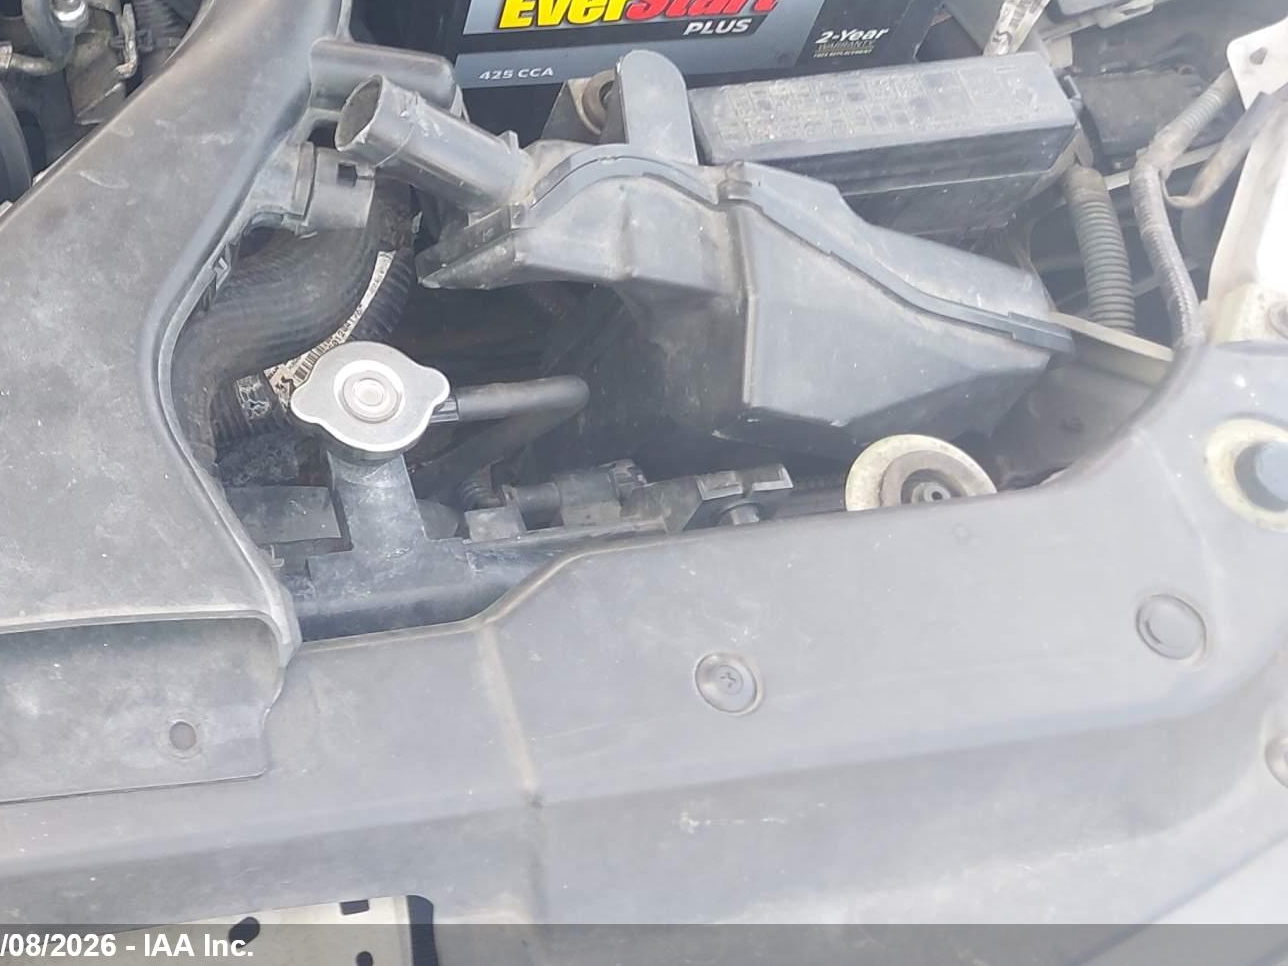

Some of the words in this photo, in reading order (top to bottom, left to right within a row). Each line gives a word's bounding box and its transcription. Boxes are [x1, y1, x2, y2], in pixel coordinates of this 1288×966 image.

[682, 17, 753, 36] PLUS
[815, 27, 889, 44] 2-Year
[478, 70, 513, 81] 425
[518, 66, 554, 78] CCA
